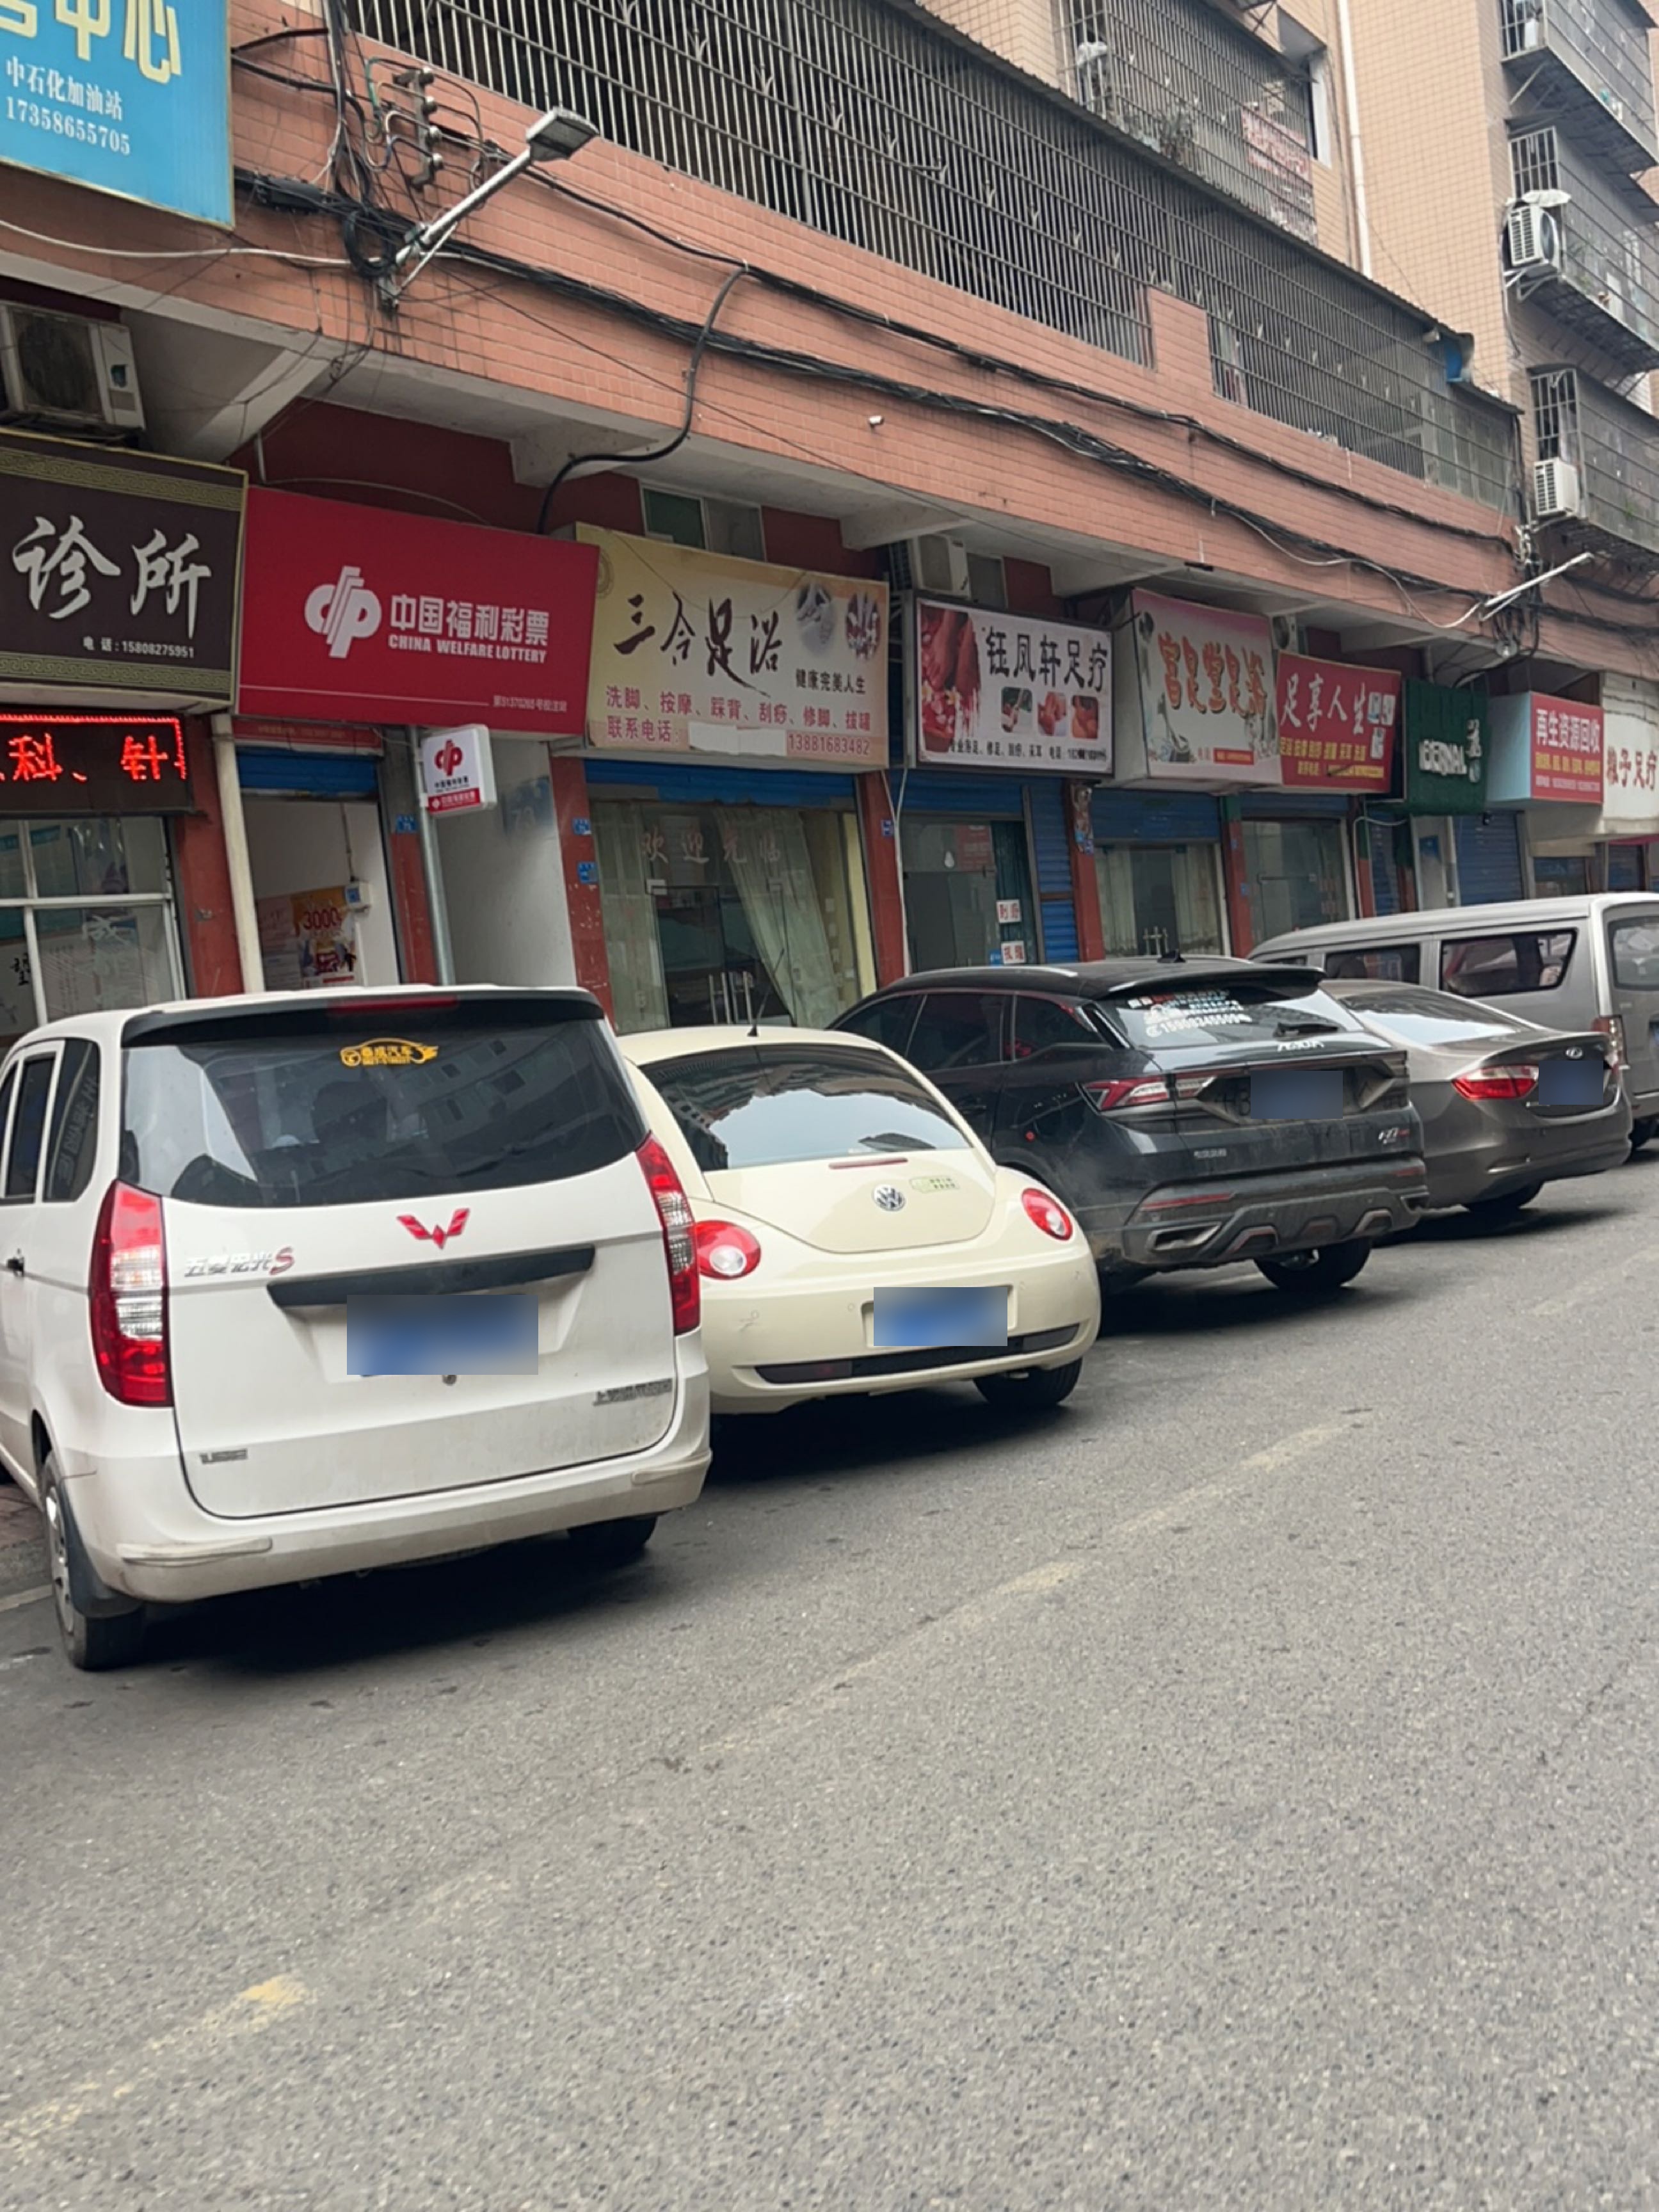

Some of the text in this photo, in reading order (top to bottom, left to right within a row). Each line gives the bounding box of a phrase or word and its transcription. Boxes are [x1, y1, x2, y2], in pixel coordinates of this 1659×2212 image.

[6, 56, 124, 121] 中石化加油站
[6, 96, 131, 156] 17358655705
[12, 515, 212, 639] 诊所
[390, 593, 550, 646] 中国福利彩票
[388, 634, 548, 664] CHINA WELFARE LOTTERY
[796, 668, 867, 695] 健康完美人生
[1279, 673, 1367, 735] 足享人生
[789, 733, 871, 756] 13881683482
[1535, 708, 1601, 754] 再生资源回收
